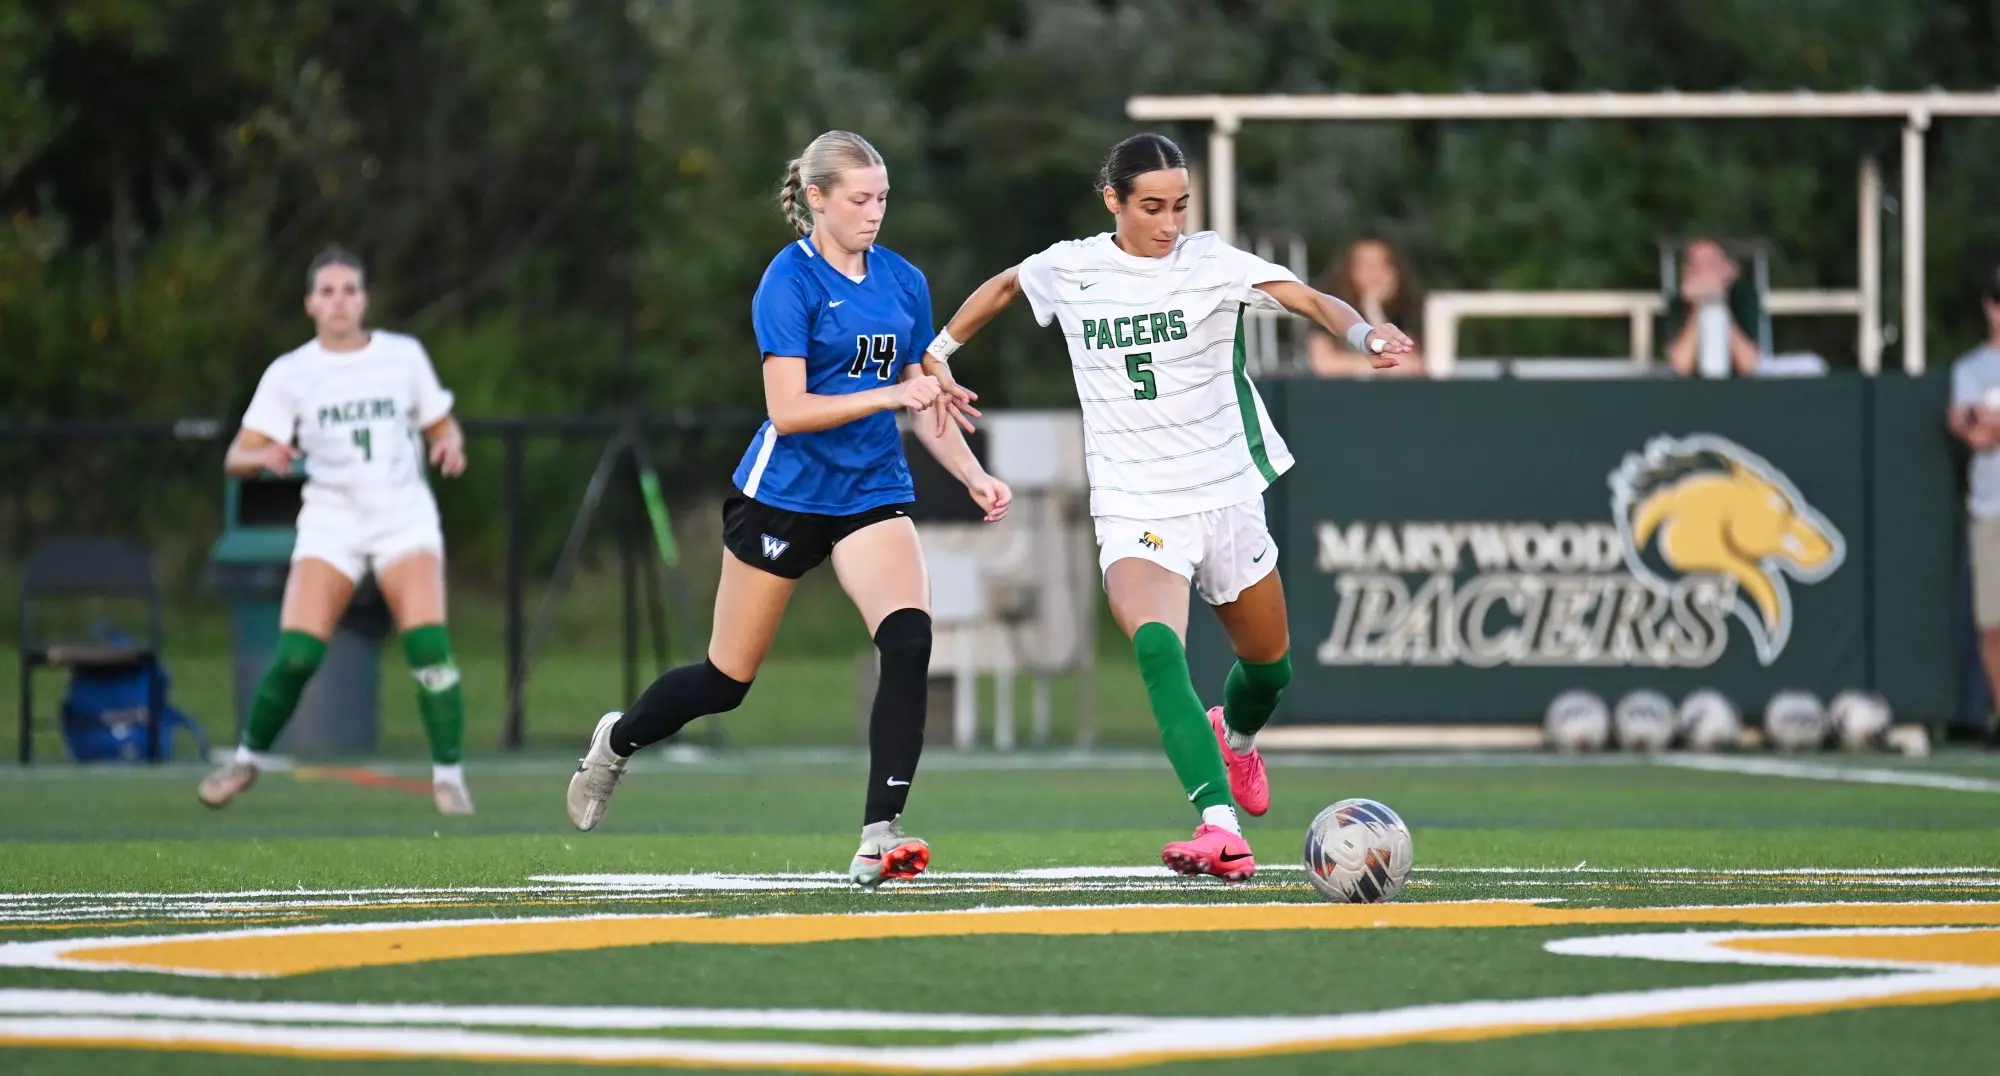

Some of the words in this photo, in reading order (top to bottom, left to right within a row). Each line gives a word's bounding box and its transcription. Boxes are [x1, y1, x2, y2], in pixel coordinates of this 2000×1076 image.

[1082, 310, 1188, 350] PACERS
[847, 333, 897, 380] 14
[1125, 352, 1157, 400] 5
[317, 398, 395, 427] PACERS
[351, 428, 371, 462] 4
[760, 533, 790, 560] W
[1316, 523, 1625, 572] MARYWOOD
[1316, 573, 1731, 667] PACERS
